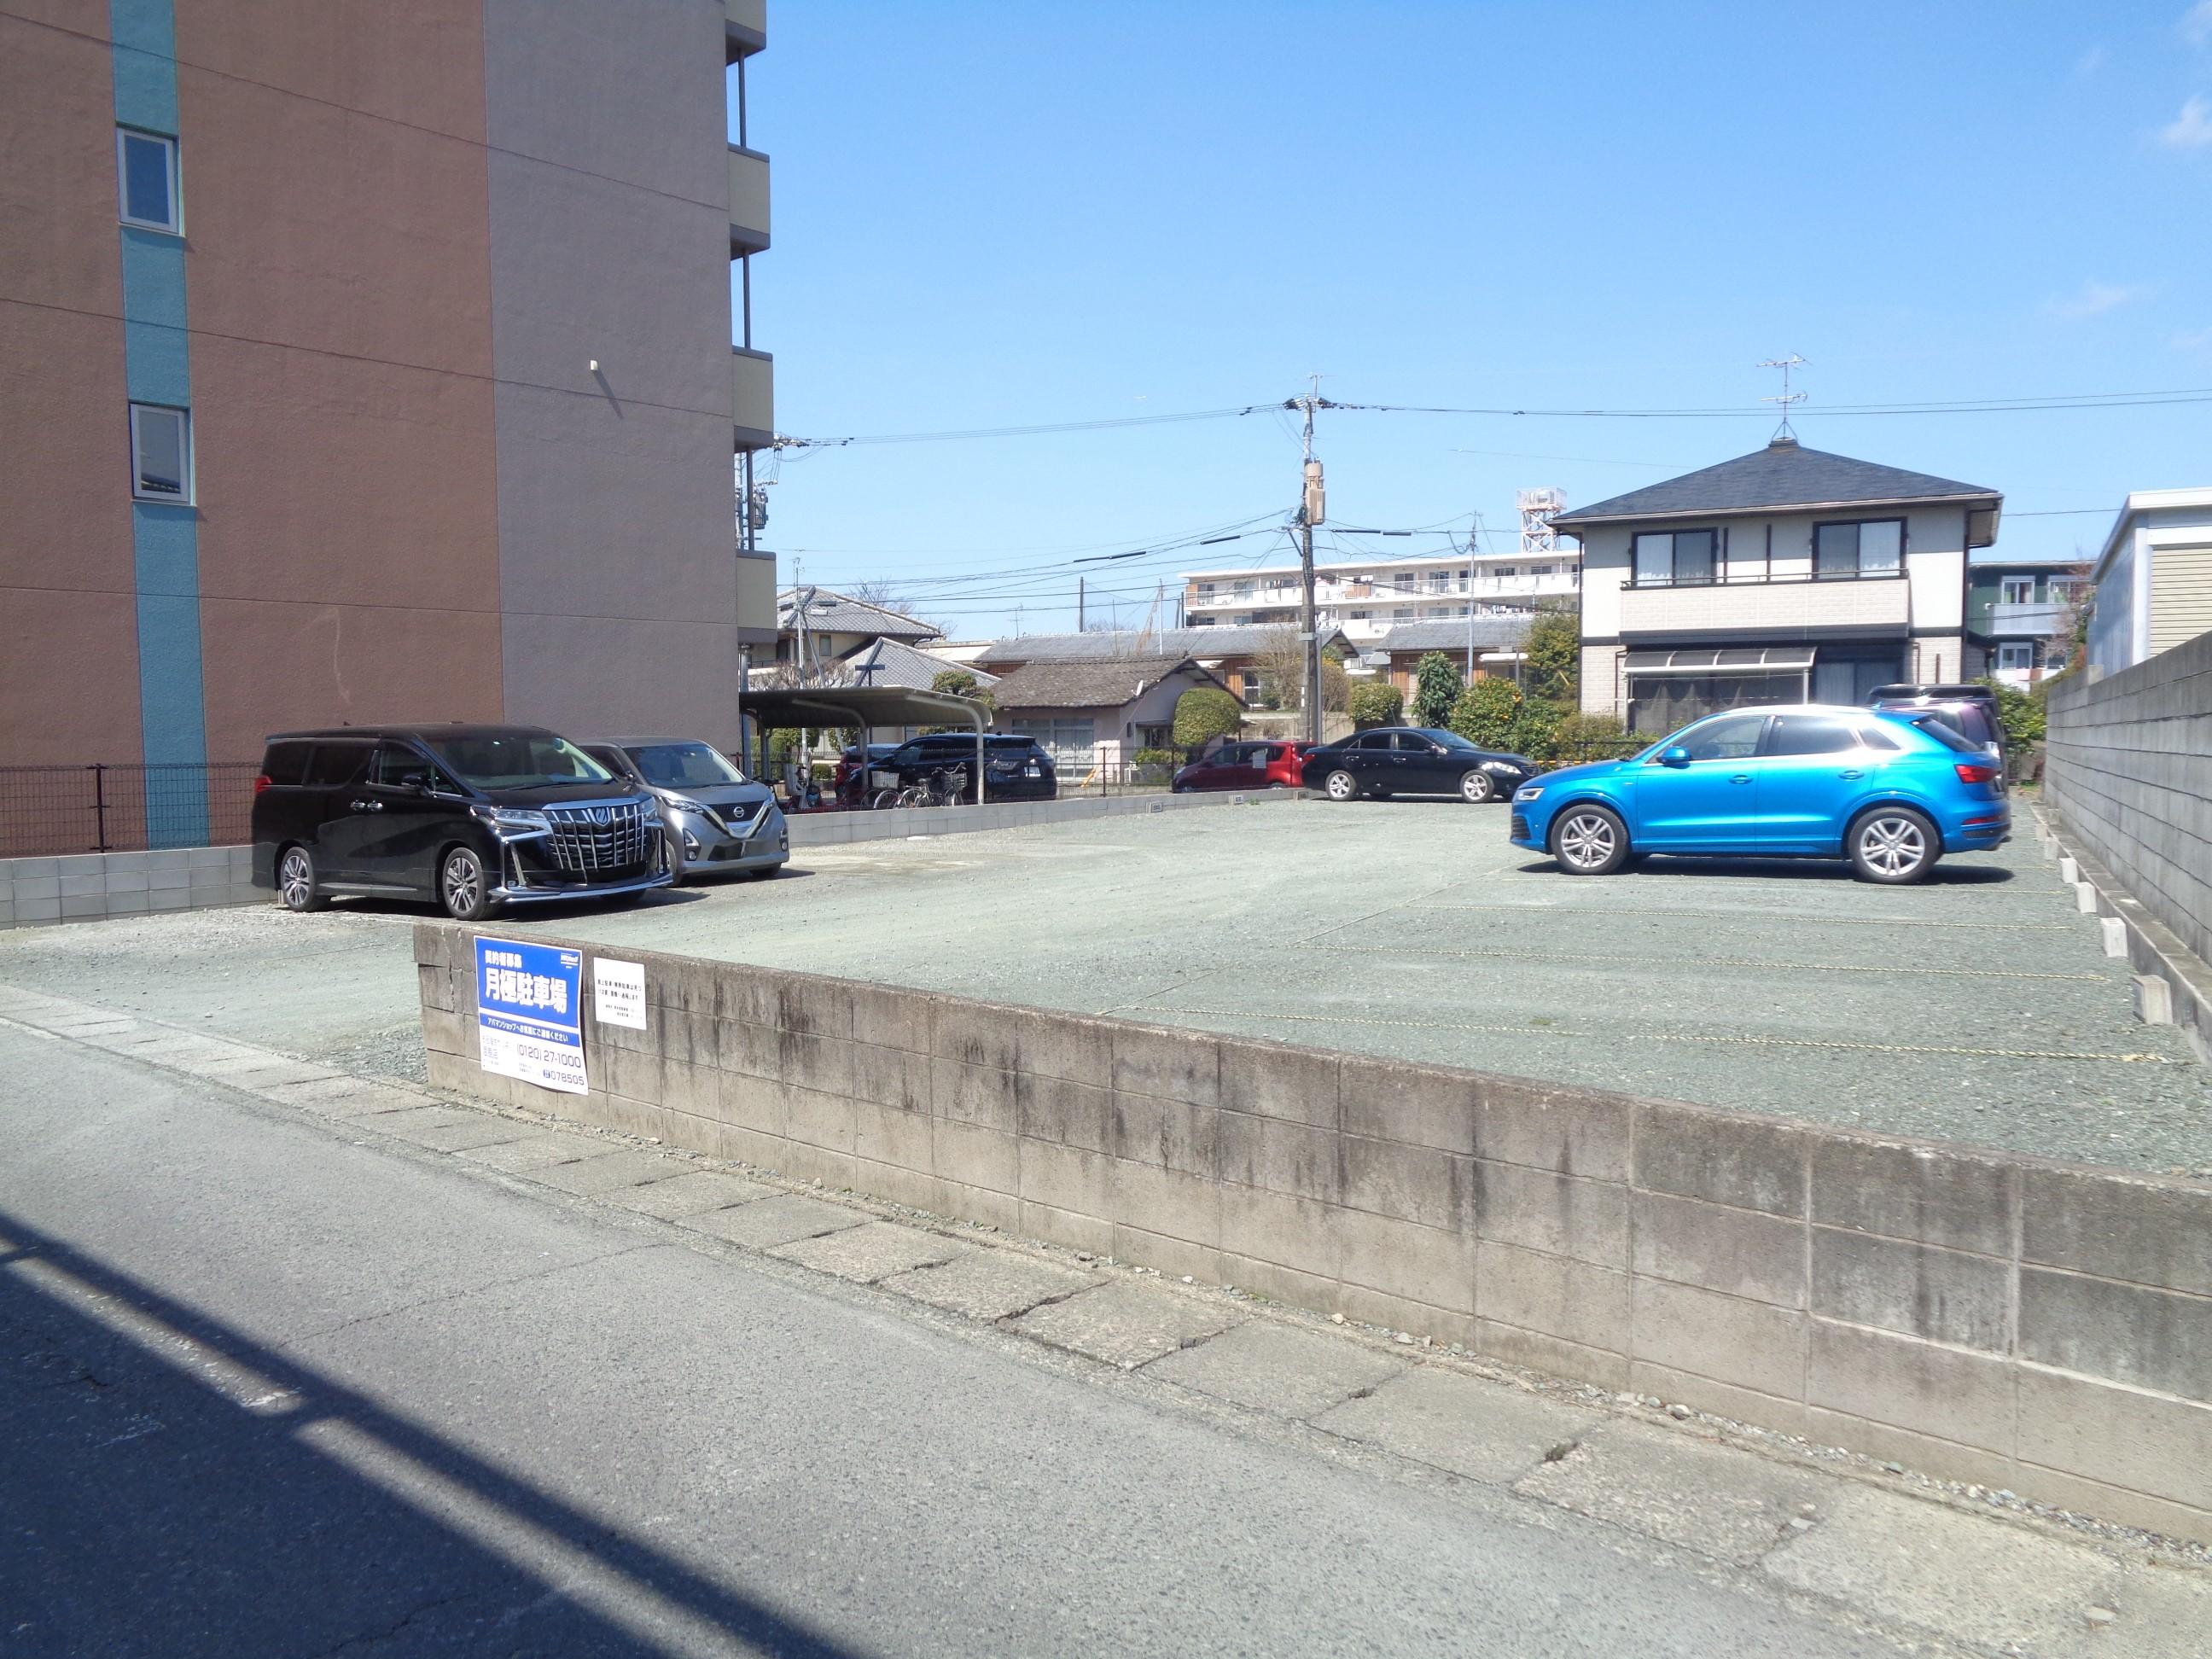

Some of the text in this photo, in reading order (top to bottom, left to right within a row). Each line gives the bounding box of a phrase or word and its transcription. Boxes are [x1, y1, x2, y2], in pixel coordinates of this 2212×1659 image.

[485, 966, 568, 1014] 月極駐車場
